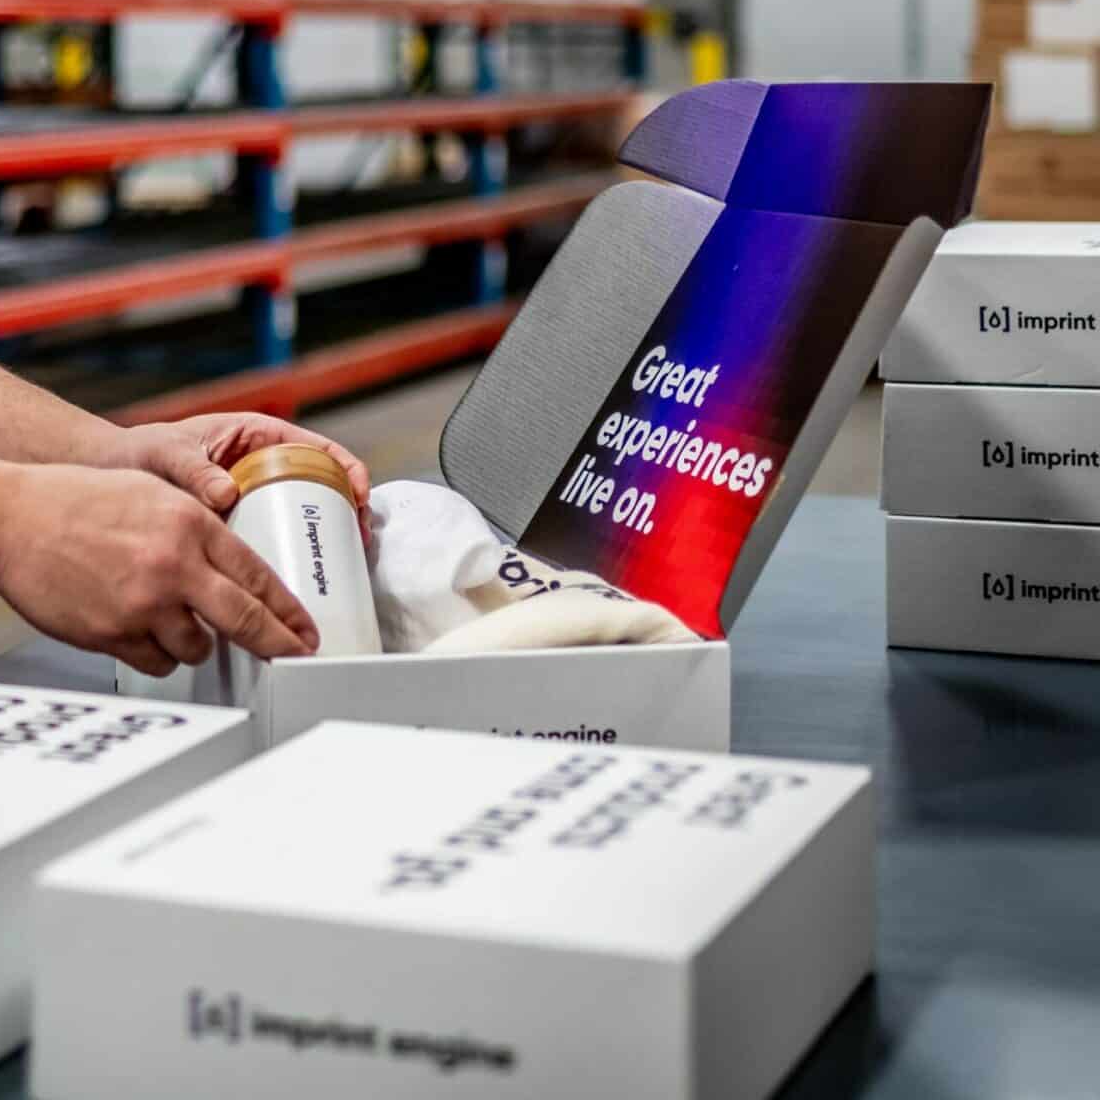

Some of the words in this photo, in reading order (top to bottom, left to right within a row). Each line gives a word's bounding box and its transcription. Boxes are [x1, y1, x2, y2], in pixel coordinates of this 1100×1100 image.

[1017, 311, 1096, 334] imprint
[632, 345, 721, 408] Great
[597, 411, 773, 498] experiences
[1020, 446, 1100, 470] imprint
[559, 453, 615, 515] live
[612, 487, 656, 535] on.
[307, 521, 323, 558] imprint
[313, 561, 329, 596] engine
[1021, 579, 1100, 604] imprint
